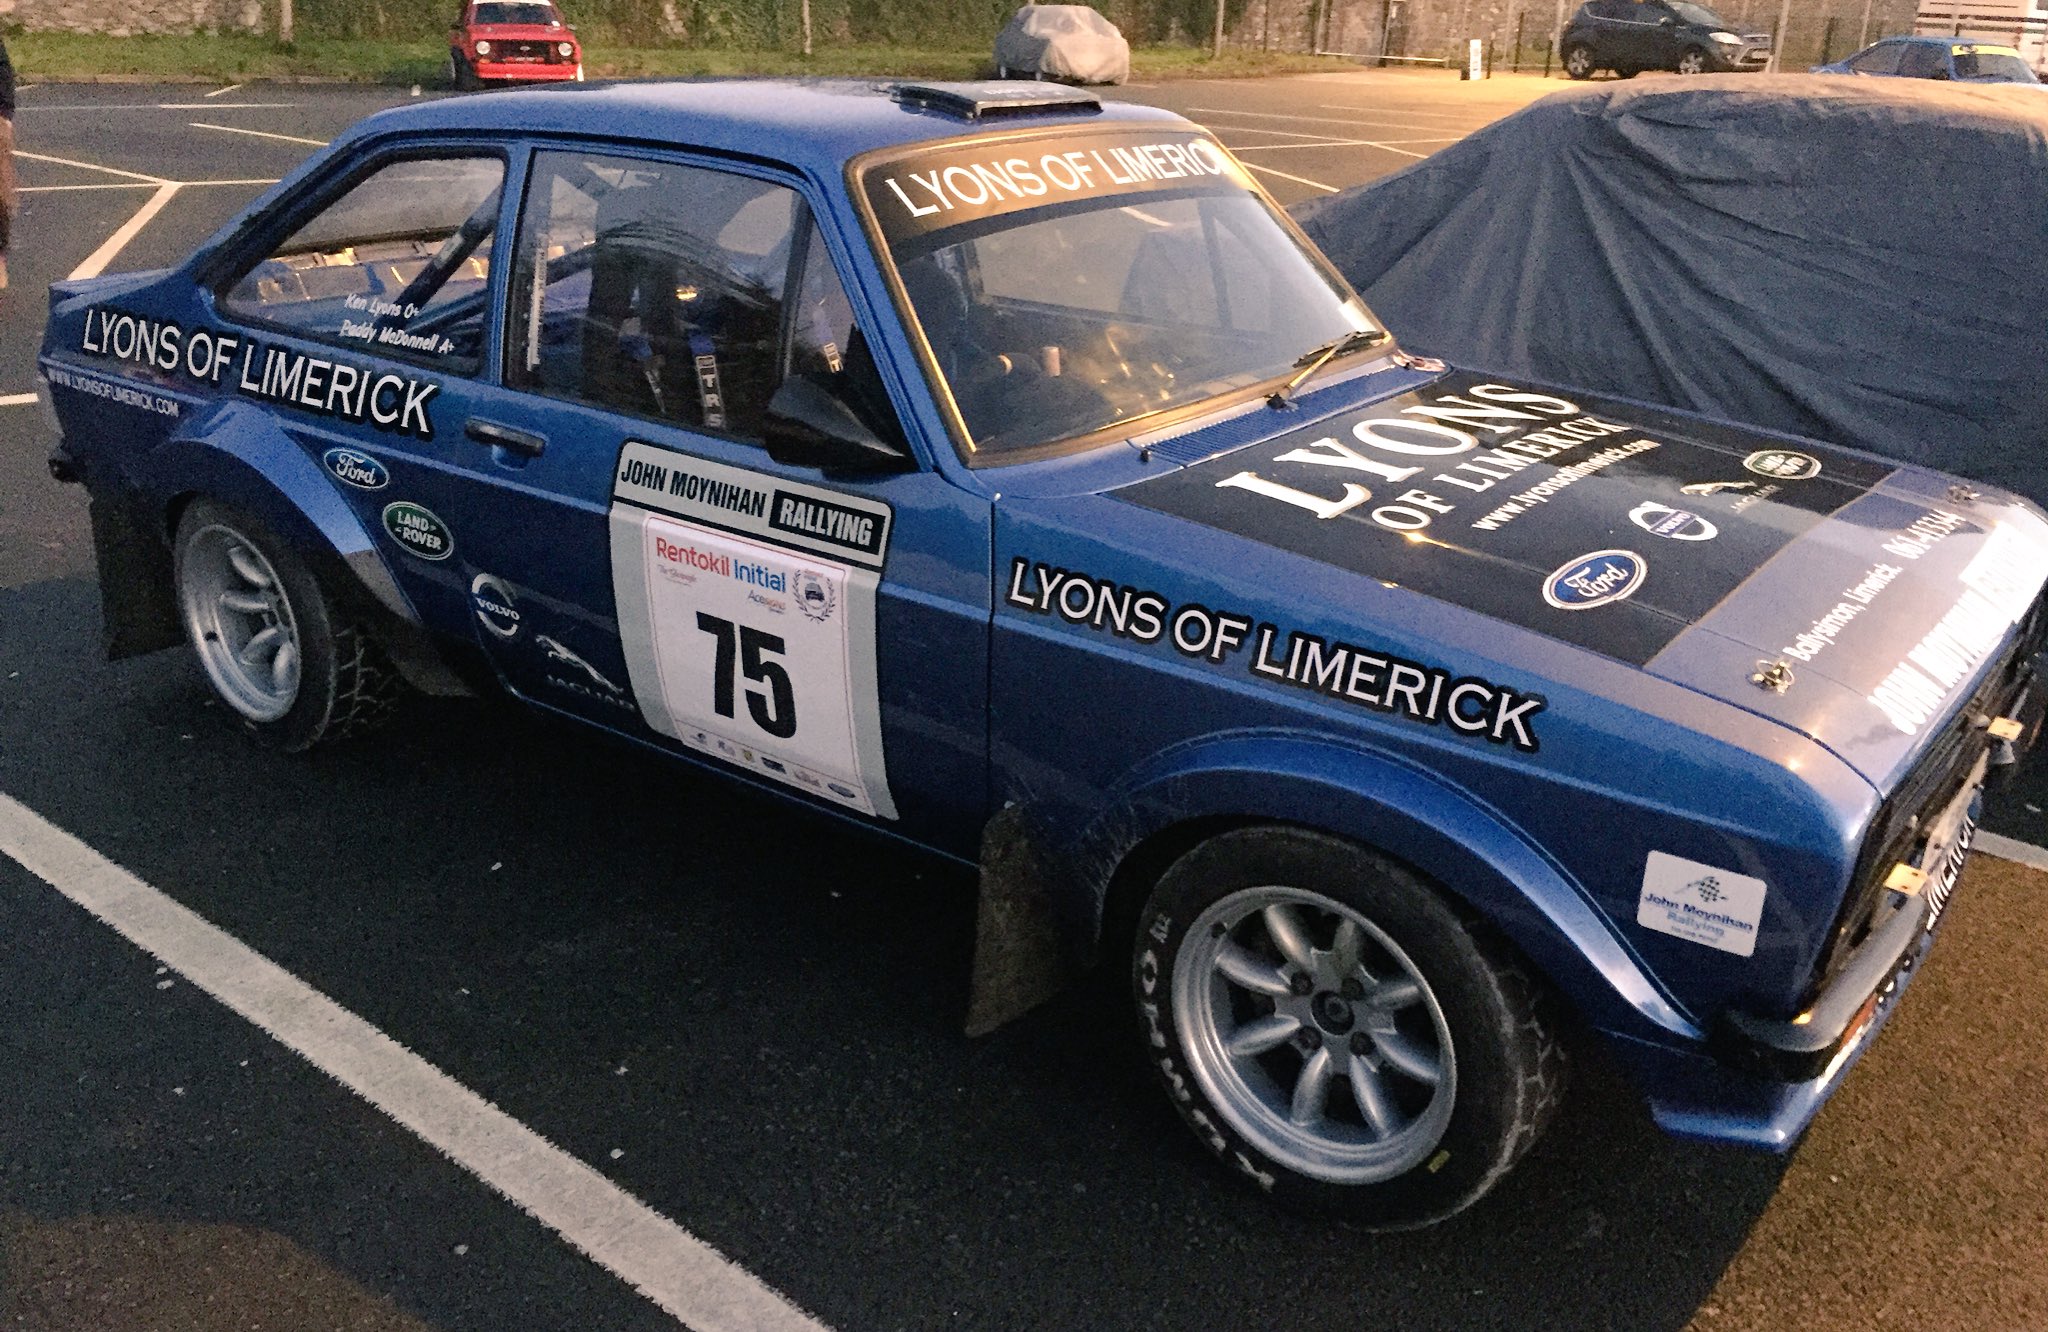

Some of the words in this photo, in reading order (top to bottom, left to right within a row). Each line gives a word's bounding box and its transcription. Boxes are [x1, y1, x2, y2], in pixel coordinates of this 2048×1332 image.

[885, 157, 1047, 218] LYONS
[1039, 151, 1096, 192] OF
[1090, 141, 1228, 185] LIMERIC
[344, 292, 368, 310] Ken
[368, 298, 402, 317] Lyons
[339, 319, 378, 344] Paddy
[378, 326, 440, 352] McDonnell
[82, 308, 181, 370] LYONS
[186, 332, 239, 382] OF
[239, 343, 438, 434] LIMERICK
[335, 451, 377, 486] Ford
[1214, 383, 1582, 520] LYONS
[1371, 488, 1456, 531] OF
[1432, 416, 1634, 493] LIMERICK
[621, 458, 668, 492] JOHN
[669, 470, 767, 518] MOYNIHAN
[779, 499, 873, 547] RALLYING
[1471, 438, 1662, 532] www.lyonsoflimerick.com
[397, 510, 430, 532] LAND
[402, 527, 442, 550] ROVER
[1655, 513, 1692, 533] VOLVO
[656, 537, 730, 577] Rentokil
[734, 559, 787, 593] Initial
[1563, 560, 1628, 599] Ford
[475, 597, 520, 621] VOLVO
[1783, 602, 1867, 662] Ballysimon,
[1842, 562, 1904, 604] Limerick.
[696, 610, 797, 739] 75
[1010, 561, 1164, 639] LYONS
[1173, 609, 1247, 660] OF
[1254, 629, 1541, 747] LIMERICK
[1645, 893, 1679, 910] John
[1667, 910, 1725, 937] Rallying
